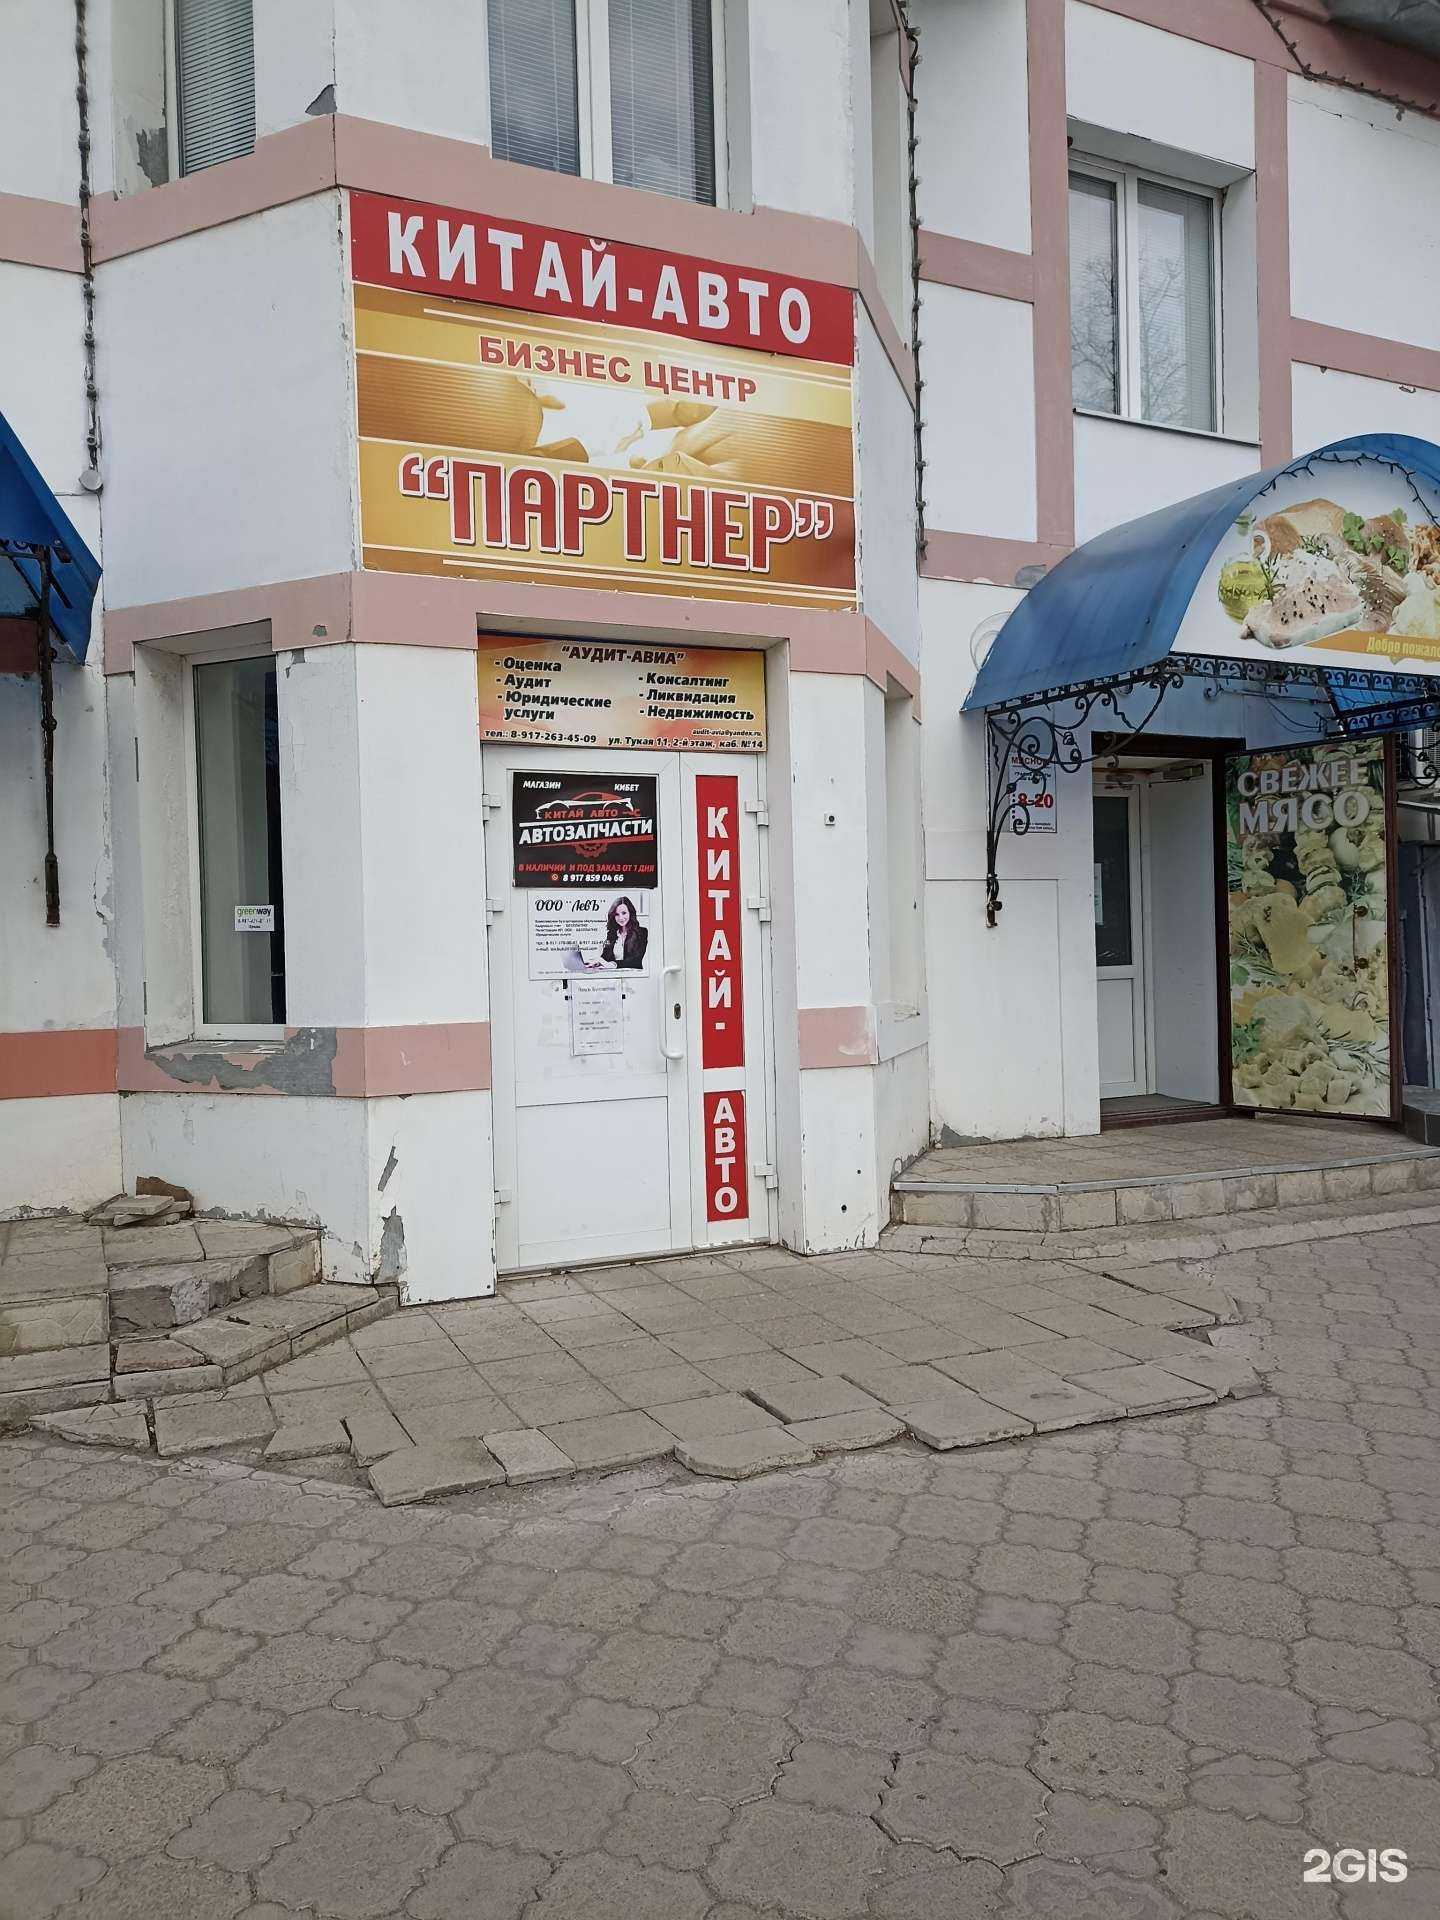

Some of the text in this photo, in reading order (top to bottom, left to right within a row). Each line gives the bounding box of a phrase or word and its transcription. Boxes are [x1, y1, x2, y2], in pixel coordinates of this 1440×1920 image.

[387, 211, 812, 344] КИТАЙ-АВТО
[479, 335, 757, 403] БИЗНЕС ЦЕНТР
[398, 452, 834, 573] “ПАРТНЕР”
[1366, 636, 1400, 653] Добро
[503, 657, 562, 672] Оценка
[504, 674, 551, 689] Аудит
[646, 672, 730, 687] Консалтинг
[506, 691, 612, 708] Юридические
[647, 689, 736, 705] Ликвидация
[504, 707, 555, 721] услуги
[647, 705, 755, 720] Недвижимость
[511, 730, 597, 743] 8-917-263-45-09
[608, 737, 622, 746] ул.
[625, 737, 654, 747] Тукая
[1237, 758, 1368, 797] СВЕЖЕЕ
[523, 780, 640, 792] МАГАЗИН КИБЕТ
[544, 809, 584, 820] КИТАЙ
[590, 808, 618, 818] АВТО
[1239, 790, 1370, 834] МЯСО
[519, 819, 653, 845] АВТОЗАПЧАСТИ
[577, 864, 595, 872] ПОД
[595, 864, 621, 872] ЗАКАЗ
[562, 874, 624, 882] 8 917 859 04 66
[535, 899, 563, 912] ООО
[713, 1097, 738, 1213] АВТО
